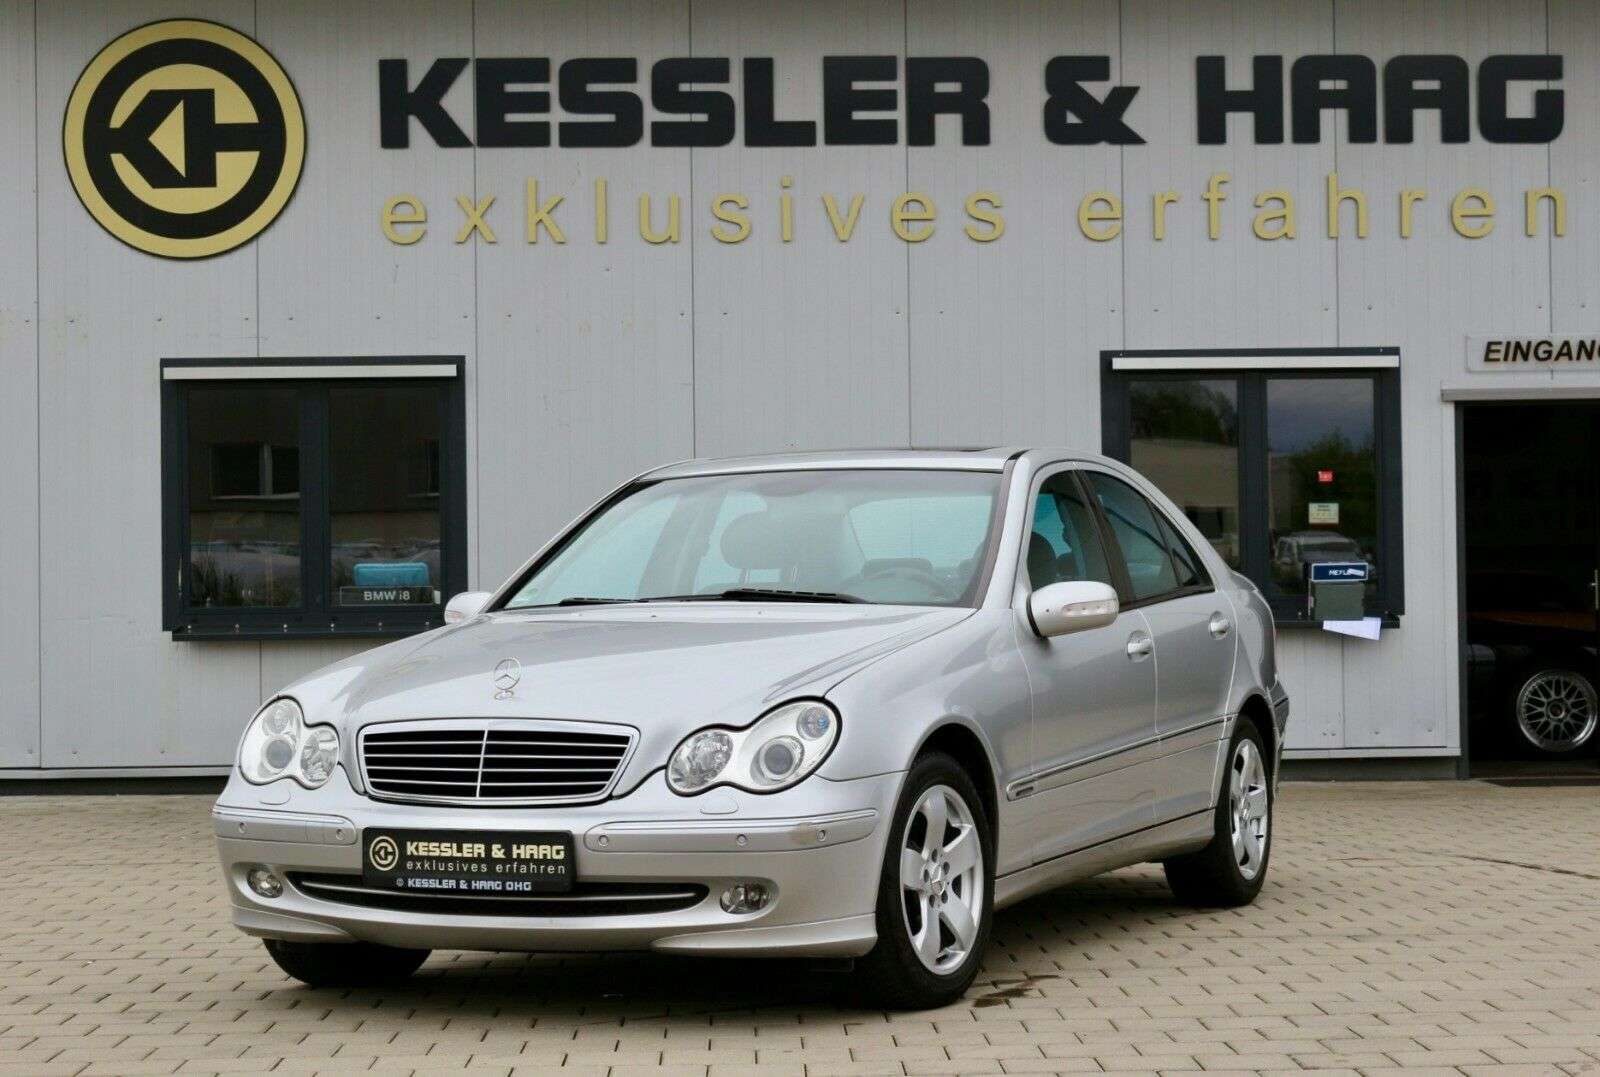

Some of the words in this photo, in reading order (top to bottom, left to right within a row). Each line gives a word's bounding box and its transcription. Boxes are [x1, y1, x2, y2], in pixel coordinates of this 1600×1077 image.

[379, 56, 990, 148] KESSLER
[1044, 56, 1147, 146] &
[1196, 54, 1565, 144] HAAG
[380, 176, 1006, 246] exklusives
[1078, 173, 1568, 243] erfahren
[1484, 339, 1600, 362] EINGAN
[364, 590, 396, 601] BMW
[399, 590, 410, 600] i8
[406, 841, 486, 858] KESSLER
[491, 844, 506, 859] &
[512, 844, 565, 860] HAAG
[406, 860, 487, 873] exklusives
[495, 862, 565, 875] erfahren
[407, 878, 457, 889] KESSLER
[459, 879, 468, 890] &
[471, 880, 503, 891] HAAG
[505, 881, 532, 892] OHG
